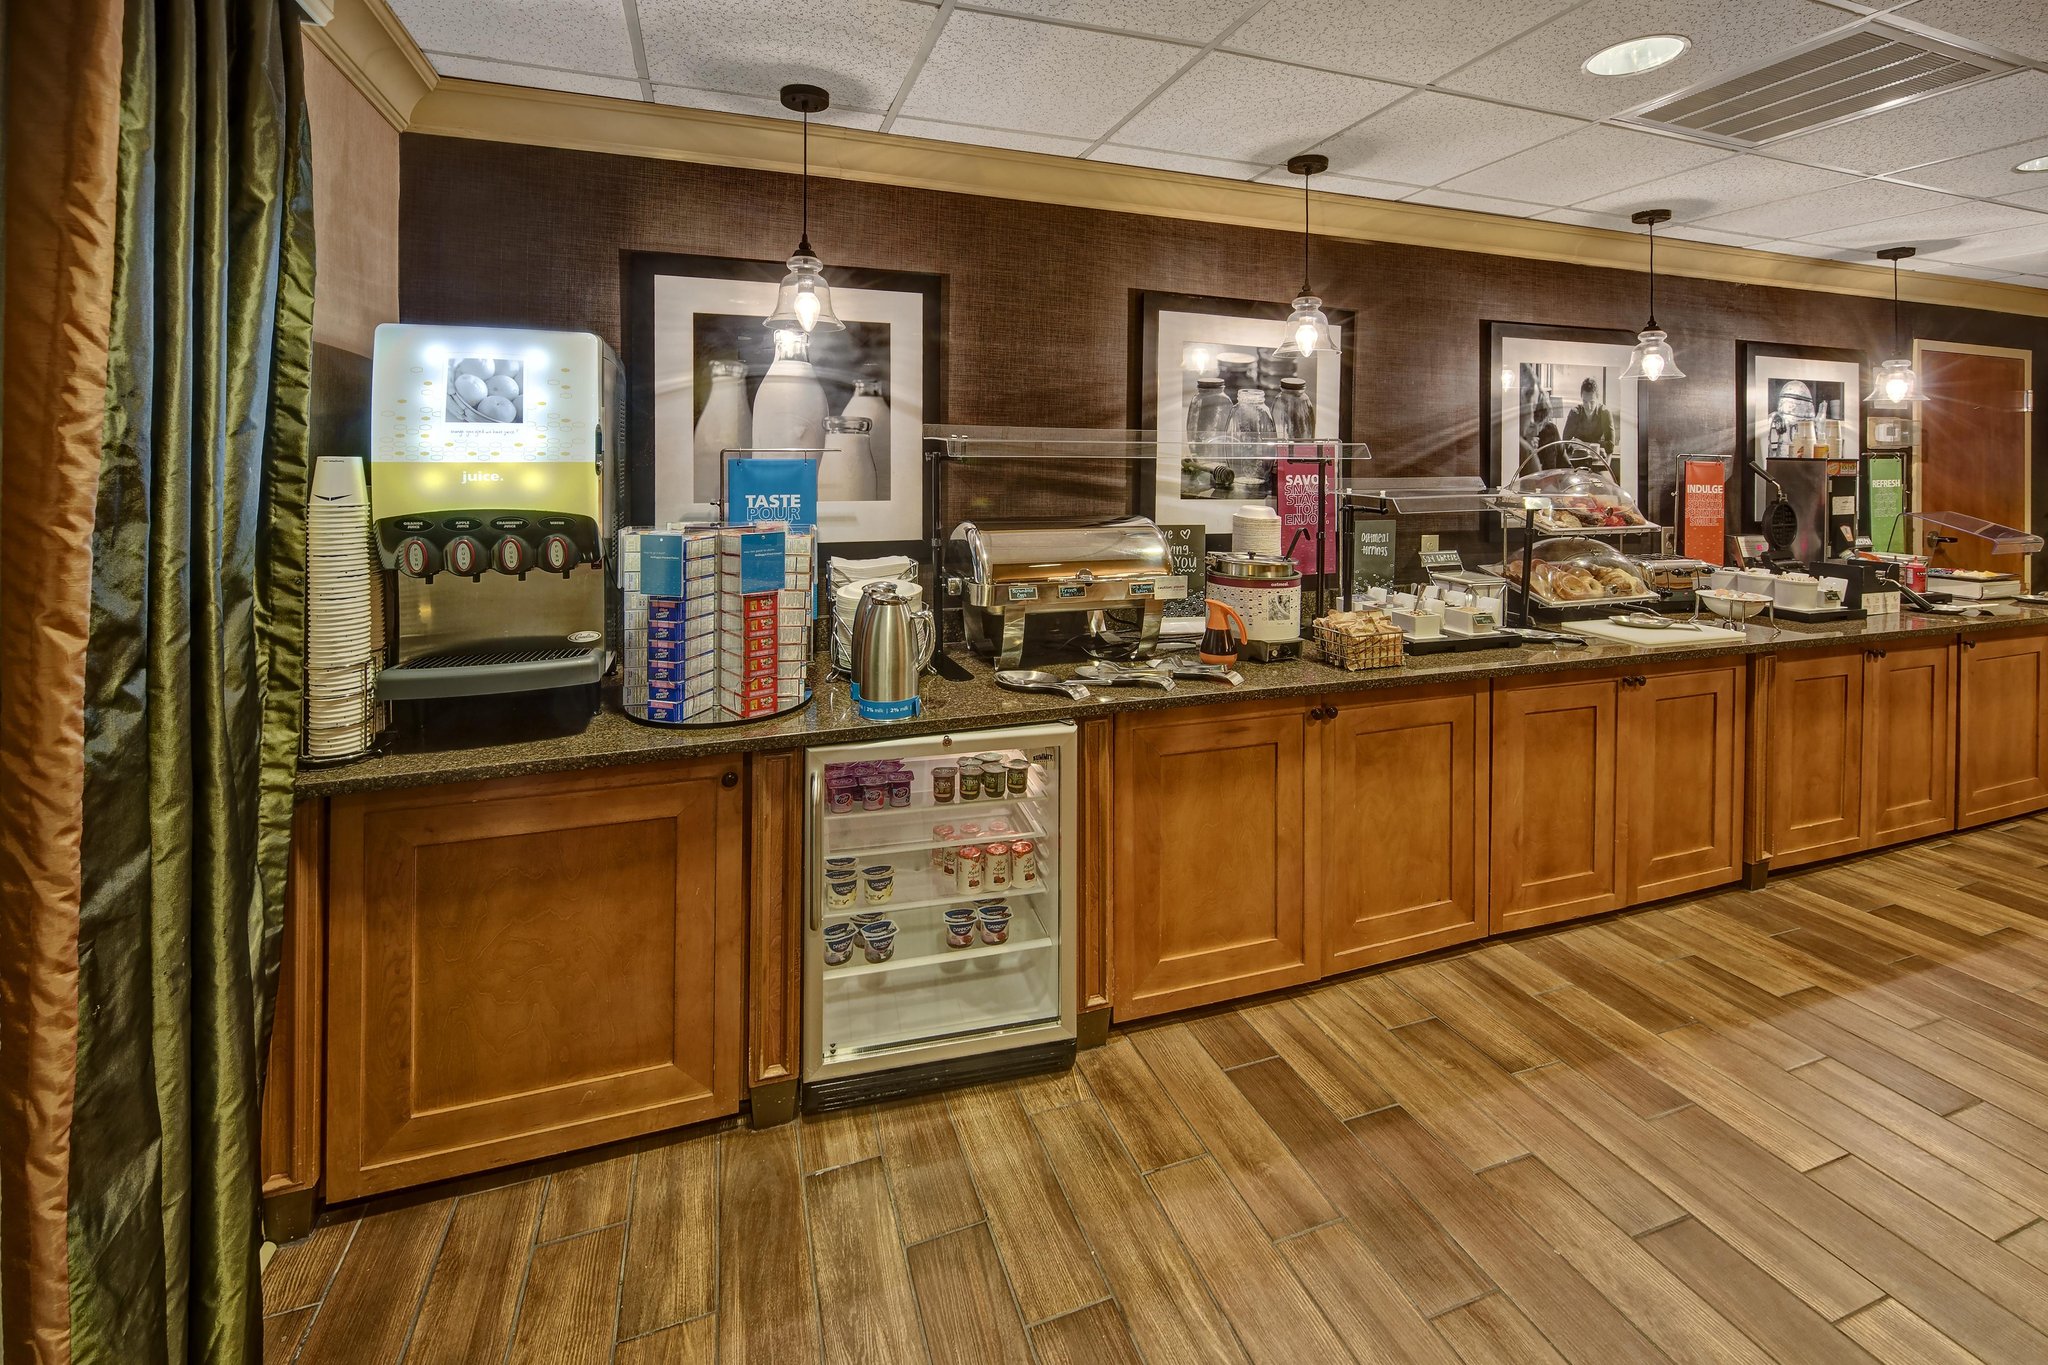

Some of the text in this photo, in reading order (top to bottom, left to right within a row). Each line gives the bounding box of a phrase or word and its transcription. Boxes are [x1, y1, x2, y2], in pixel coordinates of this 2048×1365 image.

[461, 470, 504, 485] juice.
[1872, 479, 1900, 488] REFRESH
[1687, 484, 1724, 494] INDULGE
[745, 494, 801, 508] TASTE
[1286, 494, 1328, 506] STAC
[746, 506, 801, 521] POUR
[1032, 753, 1054, 761] SUMMIT
